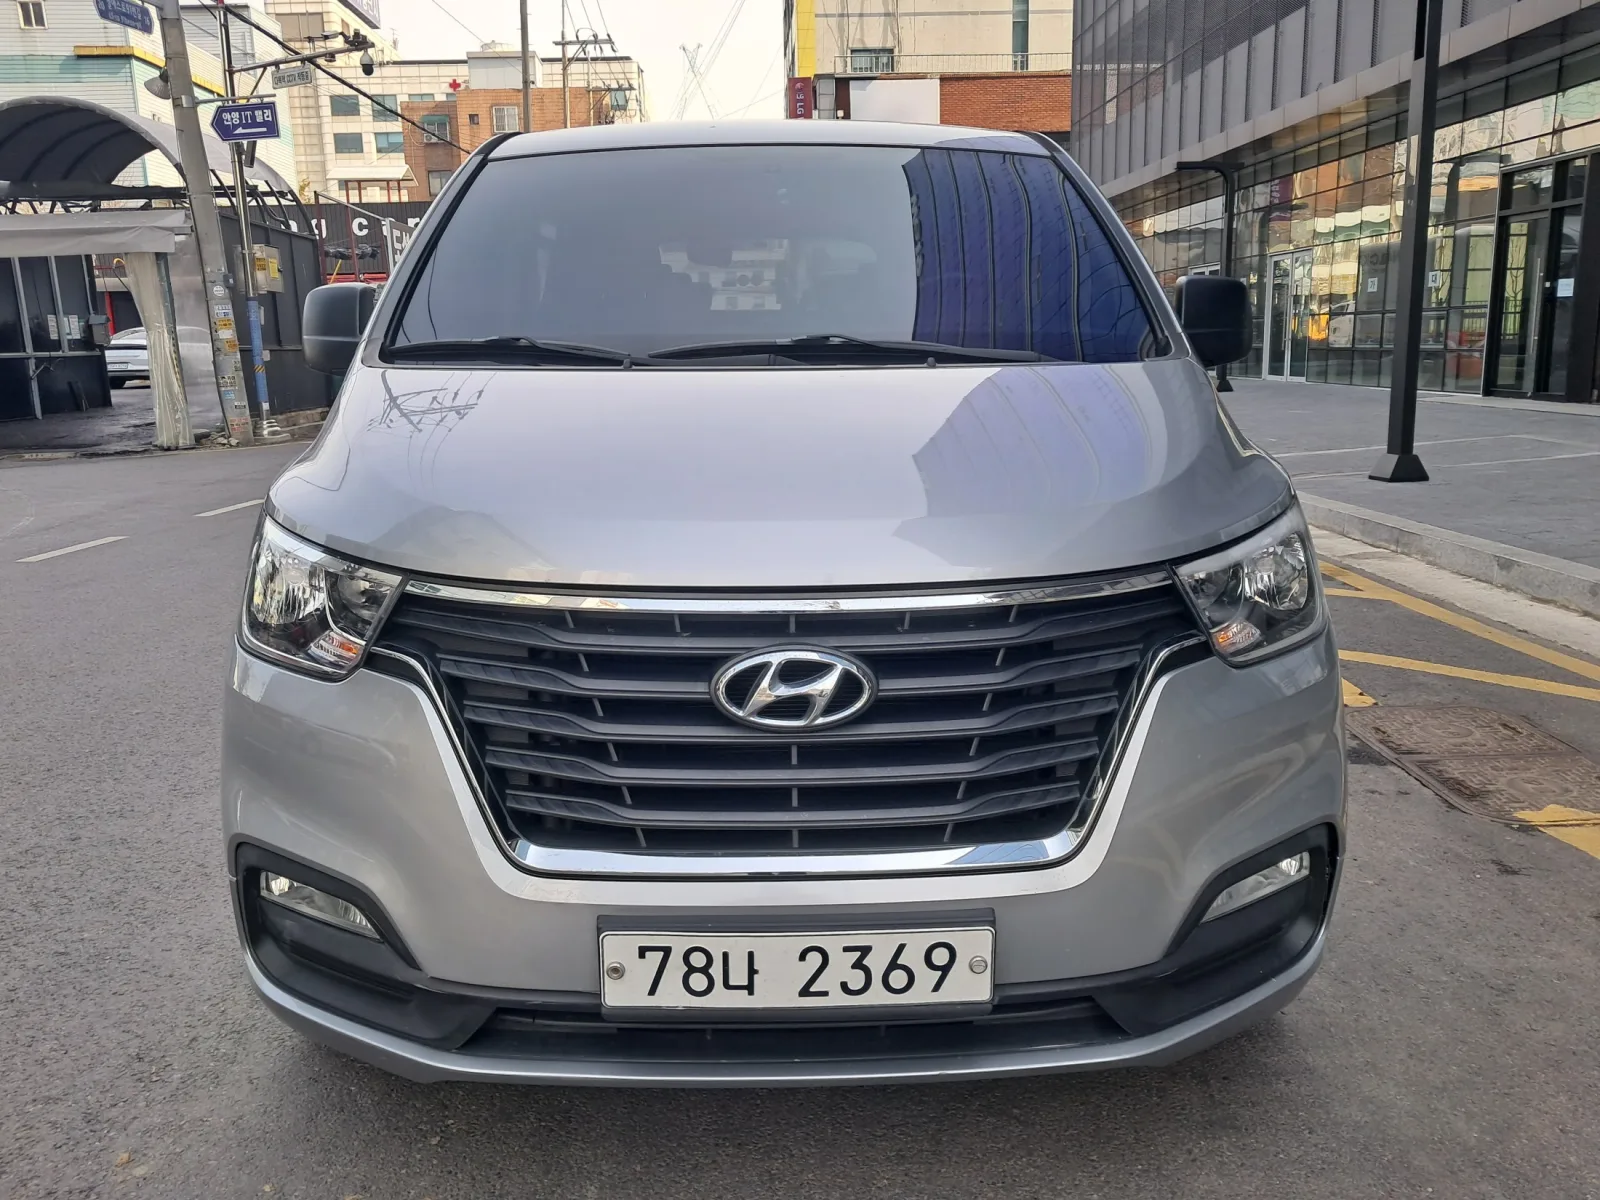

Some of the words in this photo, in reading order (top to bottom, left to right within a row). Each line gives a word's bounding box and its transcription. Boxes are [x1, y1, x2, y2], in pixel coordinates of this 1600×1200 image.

[254, 109, 272, 123] 밸리
[637, 945, 760, 997] 78나
[797, 941, 958, 998] 2369
